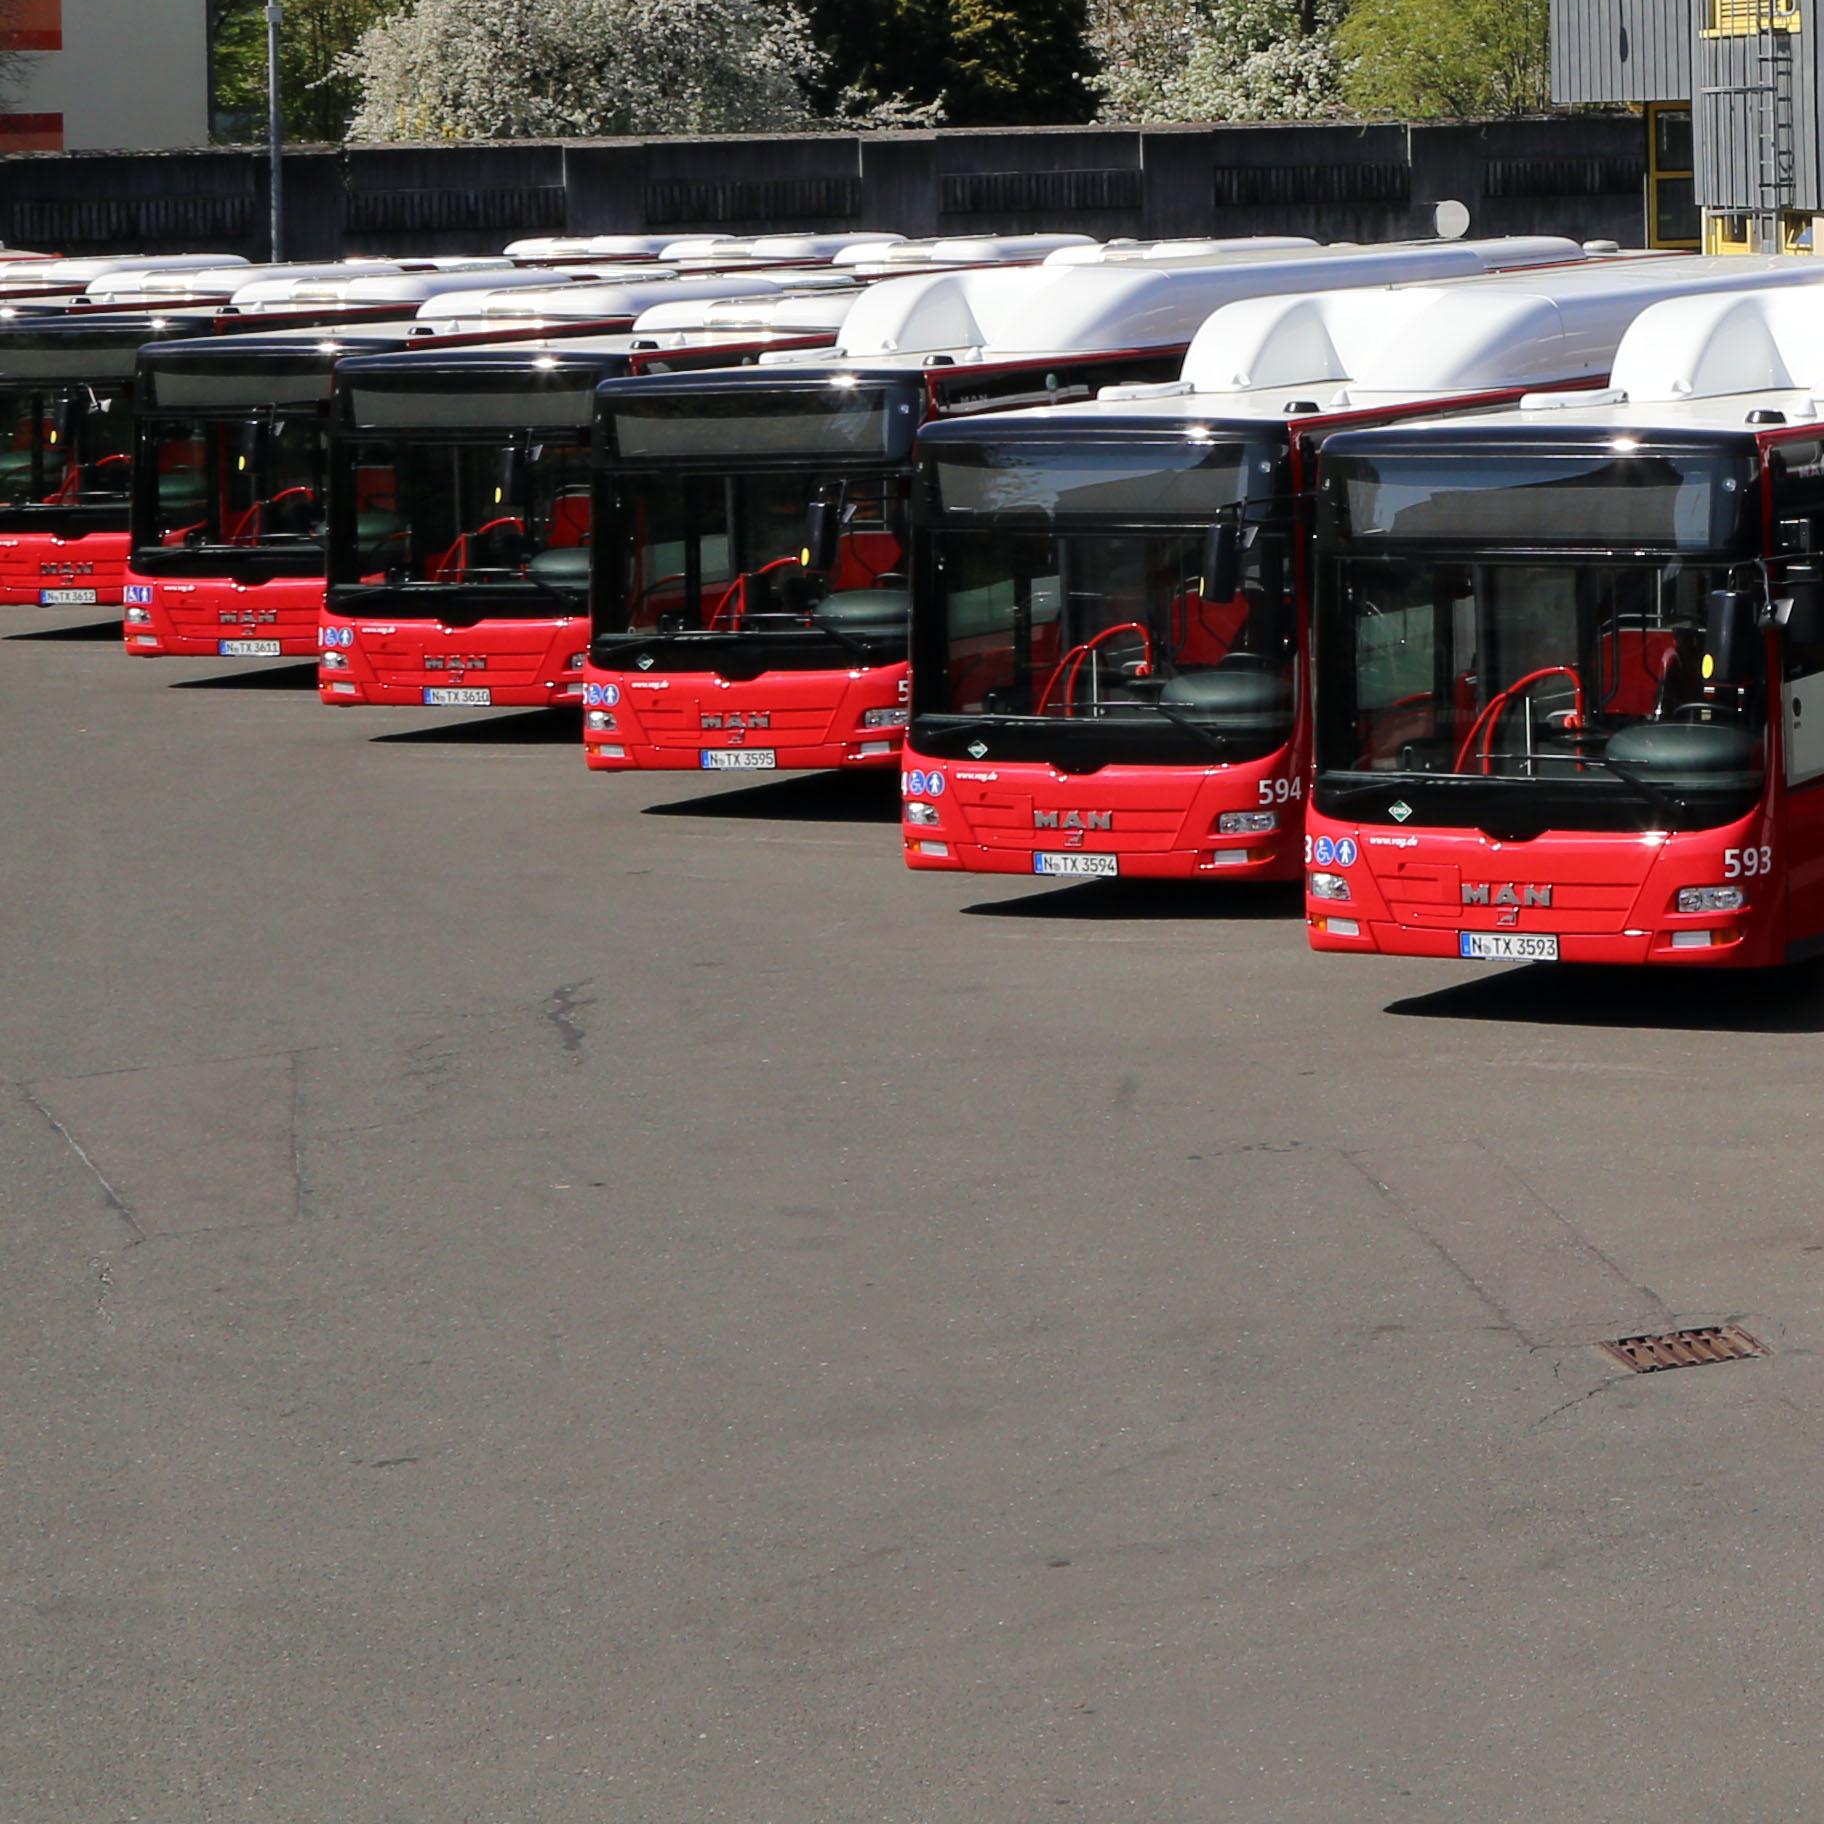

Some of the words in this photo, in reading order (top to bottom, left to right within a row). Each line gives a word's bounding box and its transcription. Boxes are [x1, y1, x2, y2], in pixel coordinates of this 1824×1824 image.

[701, 710, 770, 728] MAN
[710, 753, 719, 766] N
[725, 753, 741, 766] TX
[744, 752, 774, 766] 3595
[1258, 776, 1302, 805] 594
[1033, 809, 1113, 829] MAN
[1044, 856, 1053, 871] N
[1062, 856, 1079, 872] TX
[1082, 857, 1115, 873] 3594
[1724, 845, 1772, 878] 593
[1461, 882, 1552, 907] MAN
[1471, 937, 1482, 954] N
[1493, 937, 1513, 955] TX
[1516, 938, 1556, 957] 3593
